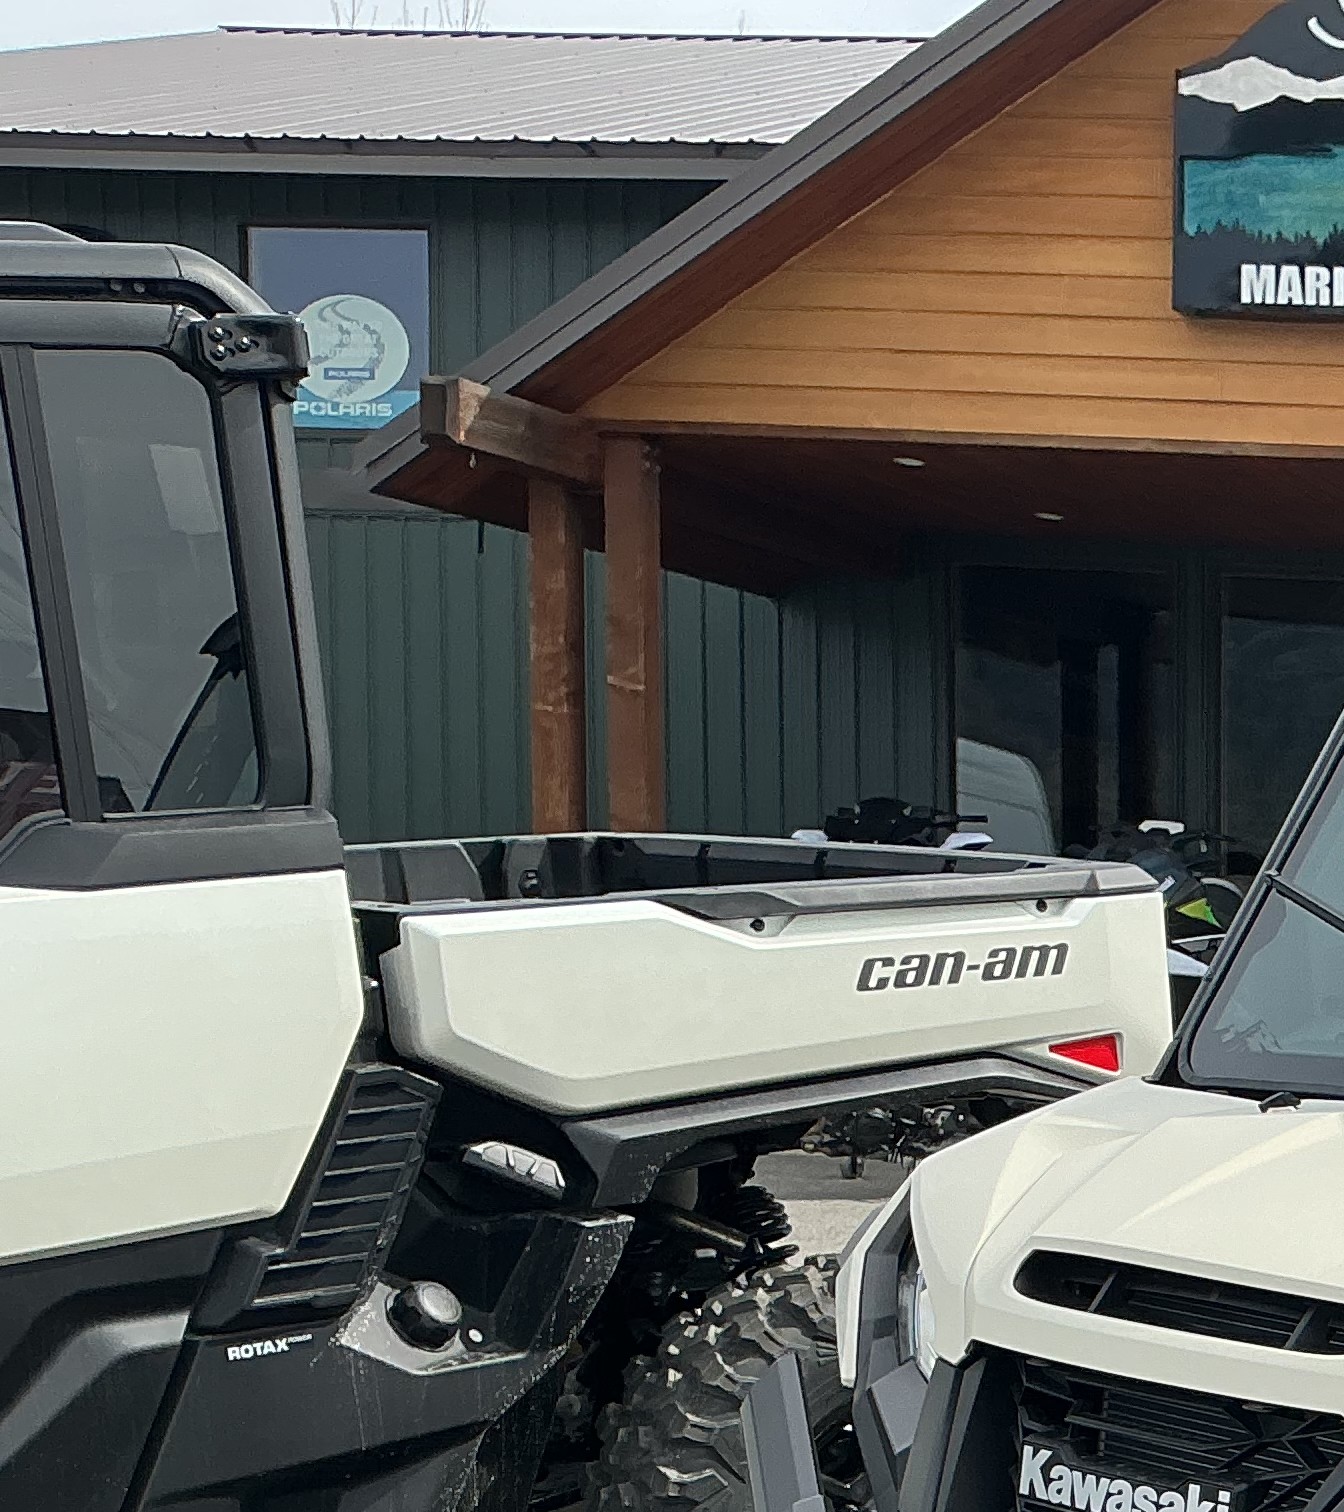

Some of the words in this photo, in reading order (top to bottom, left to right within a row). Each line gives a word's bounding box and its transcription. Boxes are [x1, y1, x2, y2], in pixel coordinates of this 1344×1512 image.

[293, 401, 393, 418] POLARIS
[855, 942, 1070, 992] can-am
[226, 1337, 290, 1361] ROTAX
